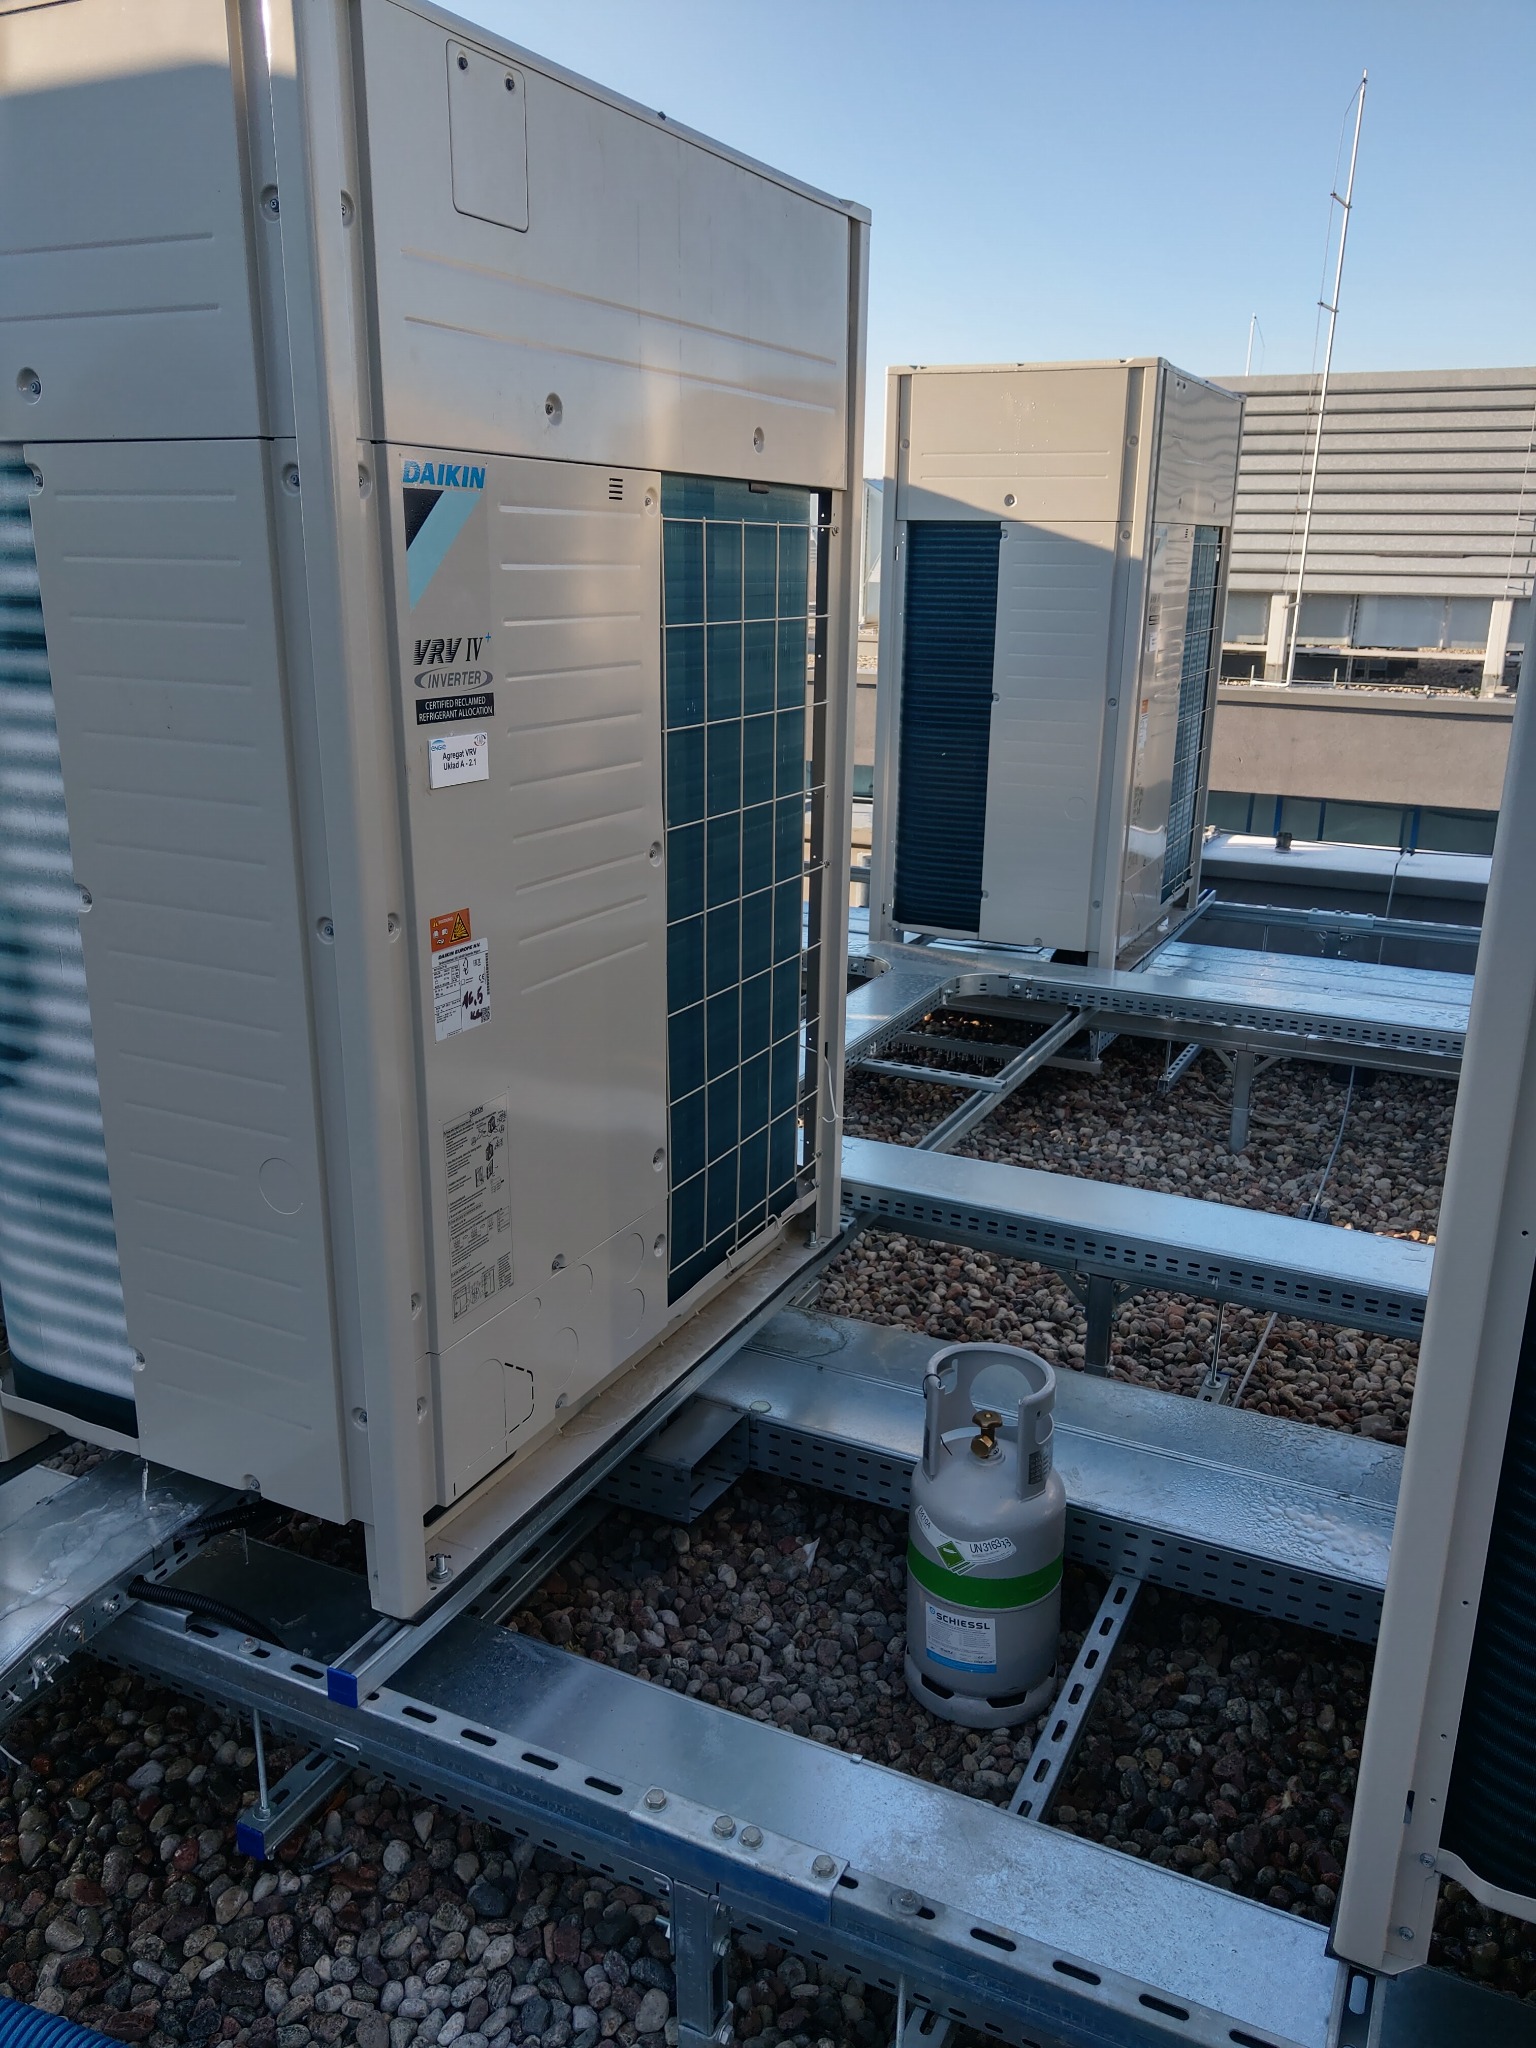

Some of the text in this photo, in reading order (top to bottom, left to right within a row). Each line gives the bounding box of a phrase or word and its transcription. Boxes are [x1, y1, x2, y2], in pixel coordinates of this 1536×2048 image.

[403, 461, 485, 488] DAIKIN
[413, 638, 462, 665] VRV
[428, 670, 482, 688] INVERTER
[425, 696, 486, 710] CERTIFIED RECLAIMED
[419, 706, 493, 722] REFRIGERANT ALLOCATION
[443, 748, 477, 761] Agregat VRV
[460, 760, 465, 768] A
[936, 1612, 991, 1630] SCHIESSL
